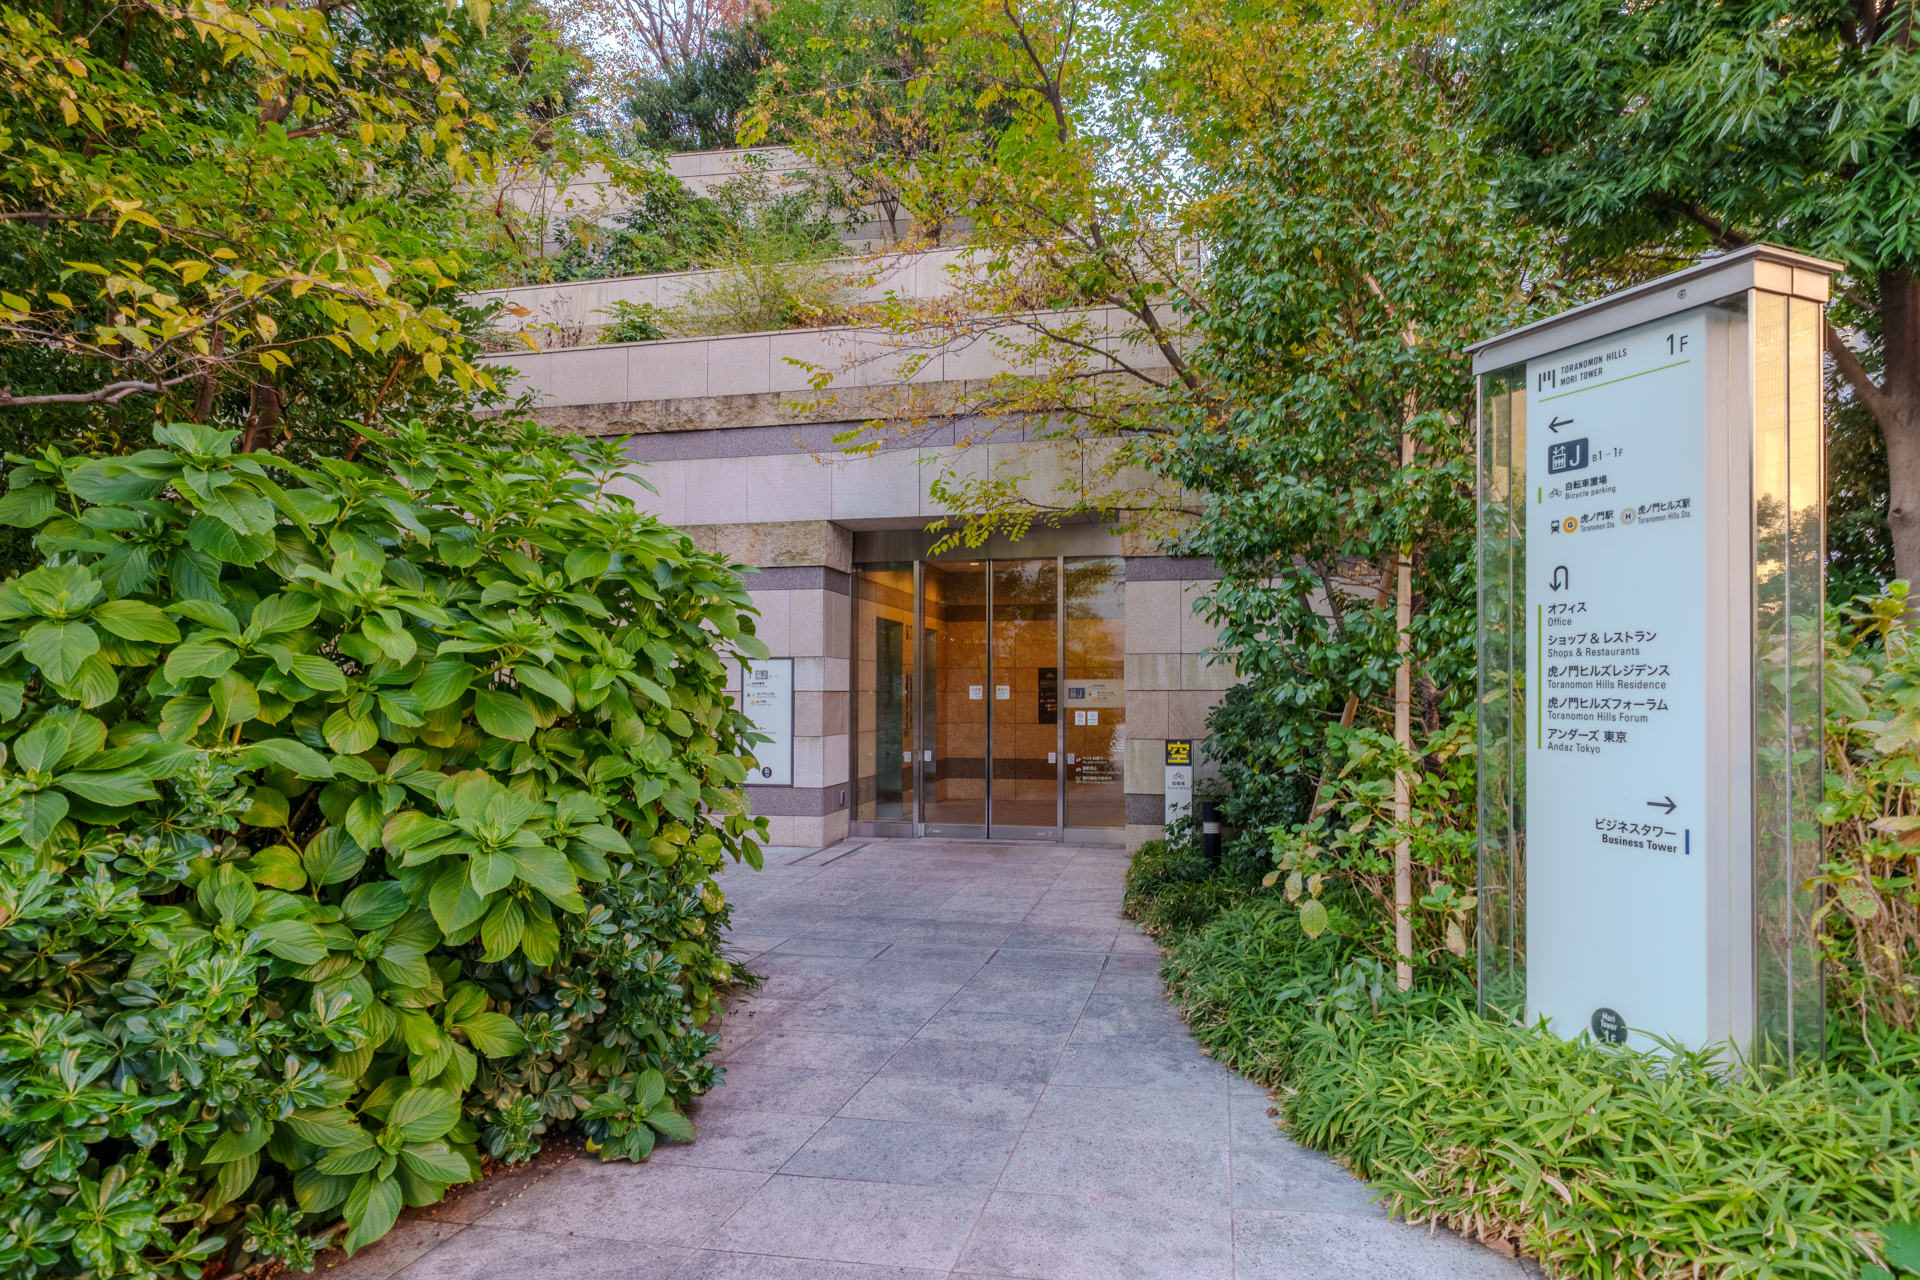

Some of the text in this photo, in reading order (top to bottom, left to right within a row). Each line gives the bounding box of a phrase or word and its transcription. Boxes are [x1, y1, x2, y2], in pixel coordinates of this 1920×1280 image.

[1666, 333, 1689, 355] 1F
[1561, 348, 1627, 375] TORANOMON HILLS
[1560, 367, 1603, 387] MORI TOWER
[1569, 444, 1580, 467] J
[1565, 475, 1608, 491] 自転車置場
[1565, 485, 1616, 500] Bicycle parking
[1638, 498, 1691, 515] 虎ノ門ヒルズ駅
[1580, 510, 1614, 524] 虎ノ門駅
[1638, 510, 1692, 525] Toranomon Hills Sta.
[1580, 521, 1616, 533] Toranomon Sta.
[1548, 602, 1587, 615] オフィス
[1548, 617, 1572, 627] Office
[1548, 630, 1657, 646] ショップ & レストラン
[1548, 647, 1640, 659] Shops & Restaurants
[1547, 664, 1670, 678] 虎ノ門ヒルズレジデンス
[1548, 680, 1667, 690] Toranomon Hills Residence
[1547, 696, 1669, 711] 虎ノ門ヒルズフォーラム
[1548, 711, 1648, 723] Toranomon Hills Forum
[1548, 728, 1627, 743] アンダーズ 東京
[1167, 741, 1190, 763] 空
[1548, 742, 1600, 755] Andaz Tokyo
[1595, 818, 1677, 838] ビジネスタワー
[1602, 833, 1677, 853] Business Tower
[1602, 1011, 1616, 1023] Mori
[1600, 1019, 1617, 1031] Tower
